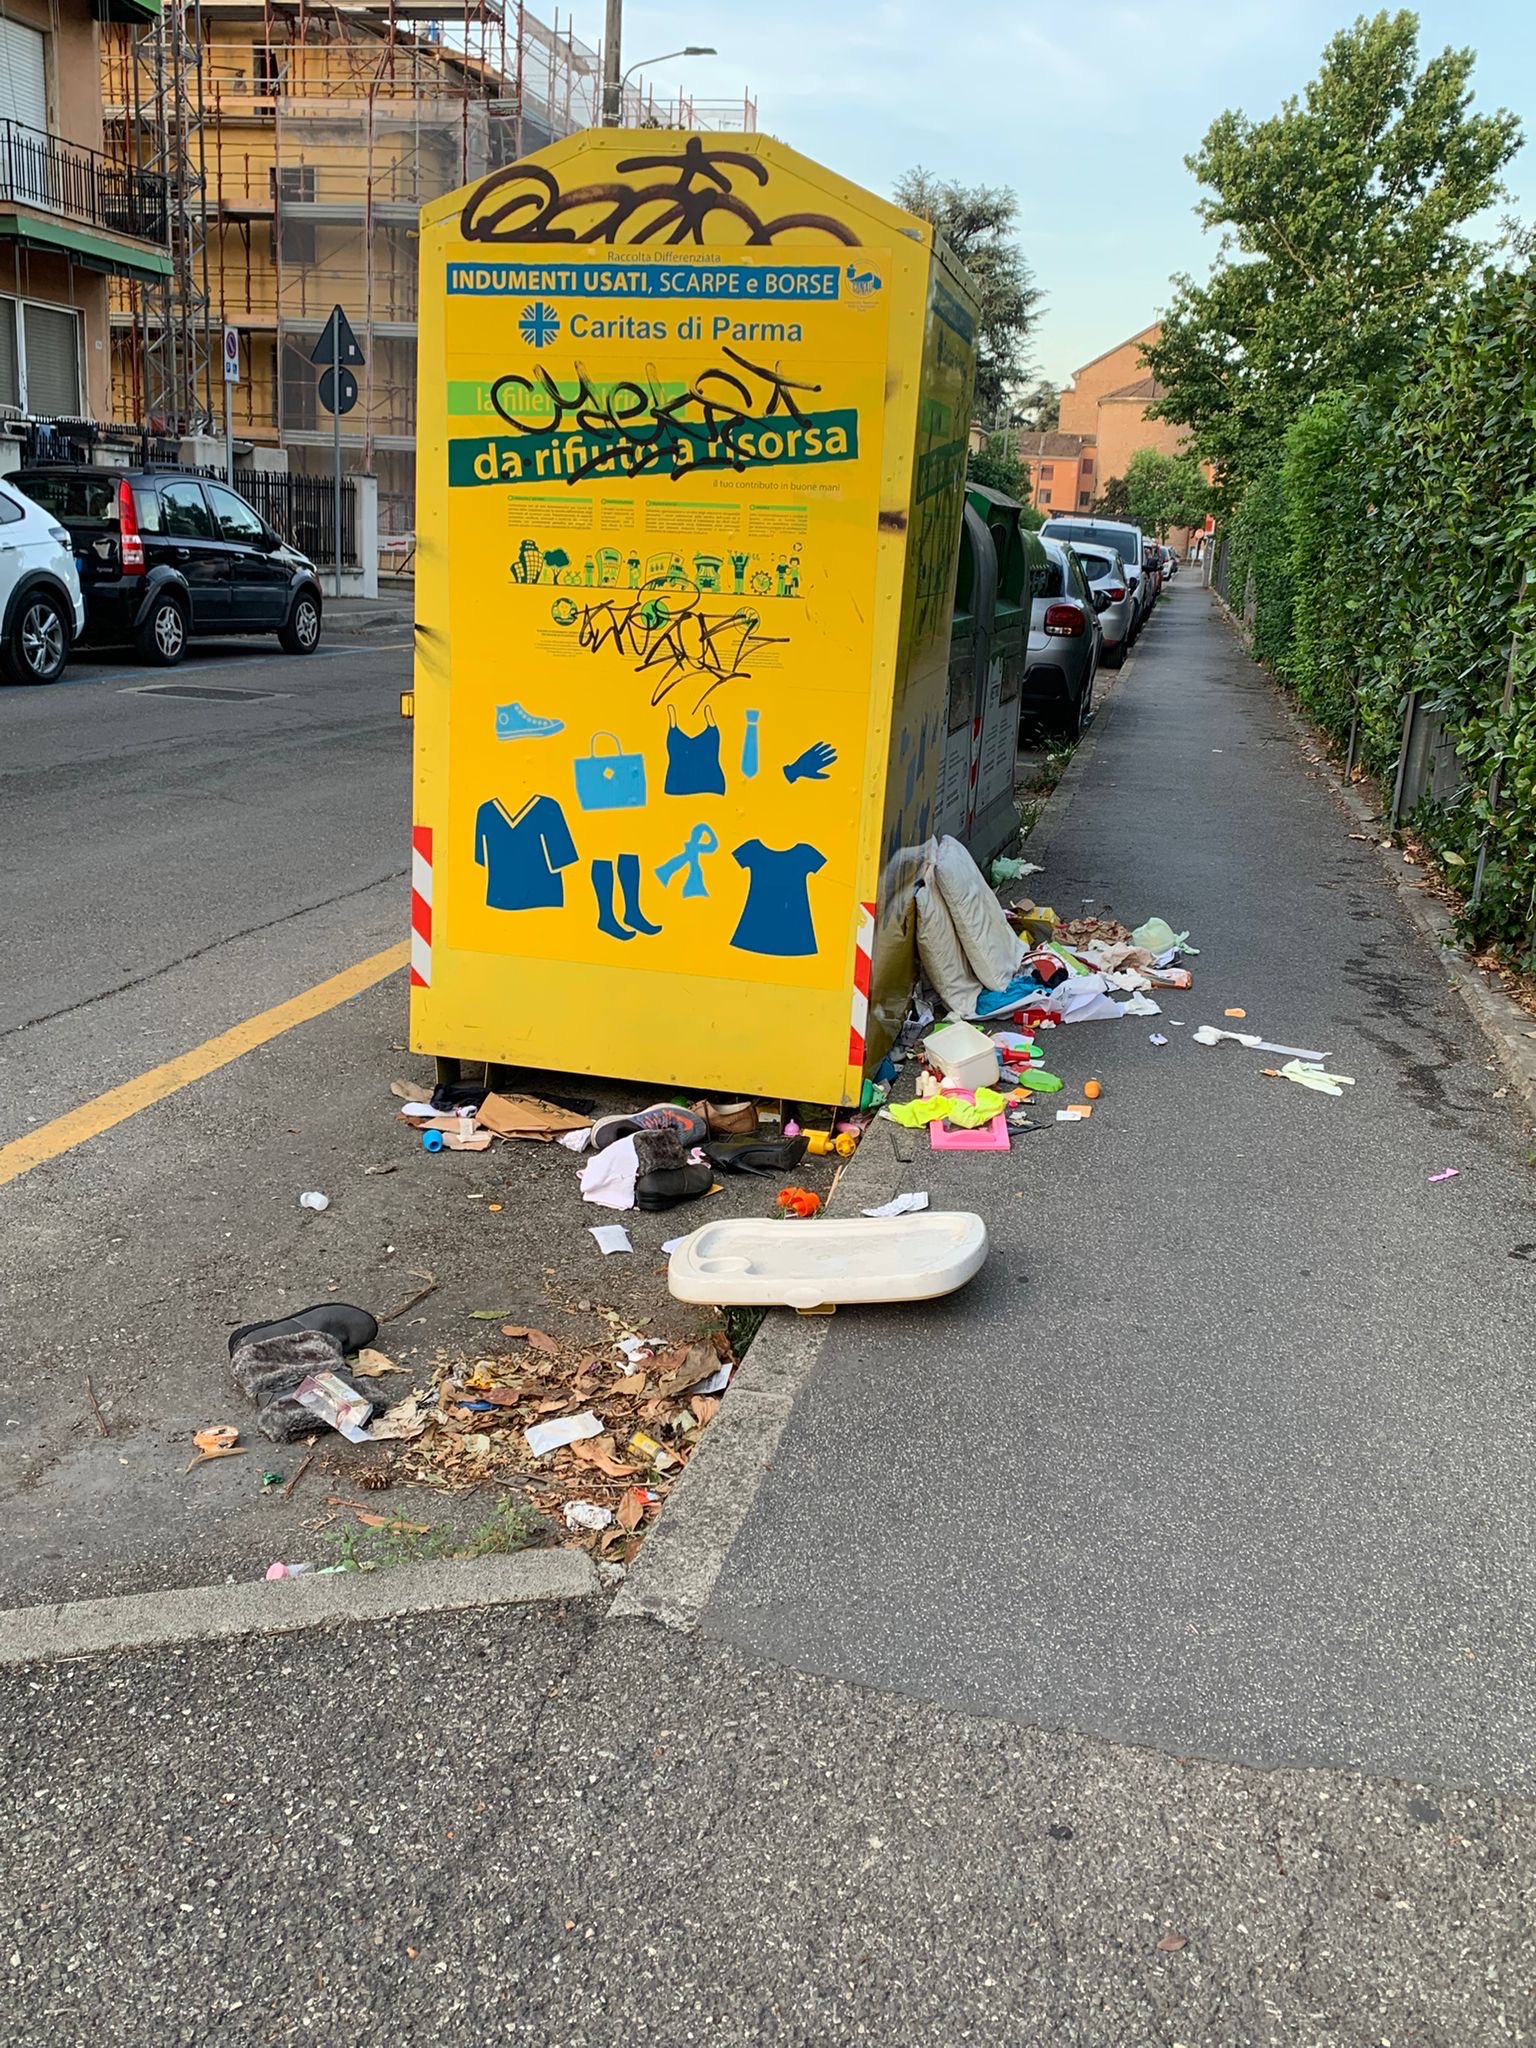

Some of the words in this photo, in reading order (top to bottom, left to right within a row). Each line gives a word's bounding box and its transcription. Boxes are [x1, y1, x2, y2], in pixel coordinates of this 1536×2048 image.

[607, 251, 651, 263] Raccolta
[654, 251, 721, 264] Differenziata
[452, 269, 577, 291] INDUMENTI
[583, 271, 653, 294] USATI,
[659, 272, 740, 293] SCARPE
[746, 278, 759, 293] e
[765, 273, 834, 294] BORSE
[570, 313, 667, 340] Caritas
[677, 316, 701, 341] di
[713, 316, 803, 342] Parma
[477, 387, 496, 412] la
[502, 386, 566, 412] filier
[473, 442, 523, 480] da
[535, 435, 660, 477] rifiuto
[672, 437, 694, 467] a
[708, 424, 848, 463] risorsa
[712, 480, 718, 488] il
[719, 481, 734, 489] tuo
[735, 480, 779, 490] contributo
[780, 482, 789, 490] in
[790, 482, 817, 491] buone
[818, 483, 841, 492] mani
